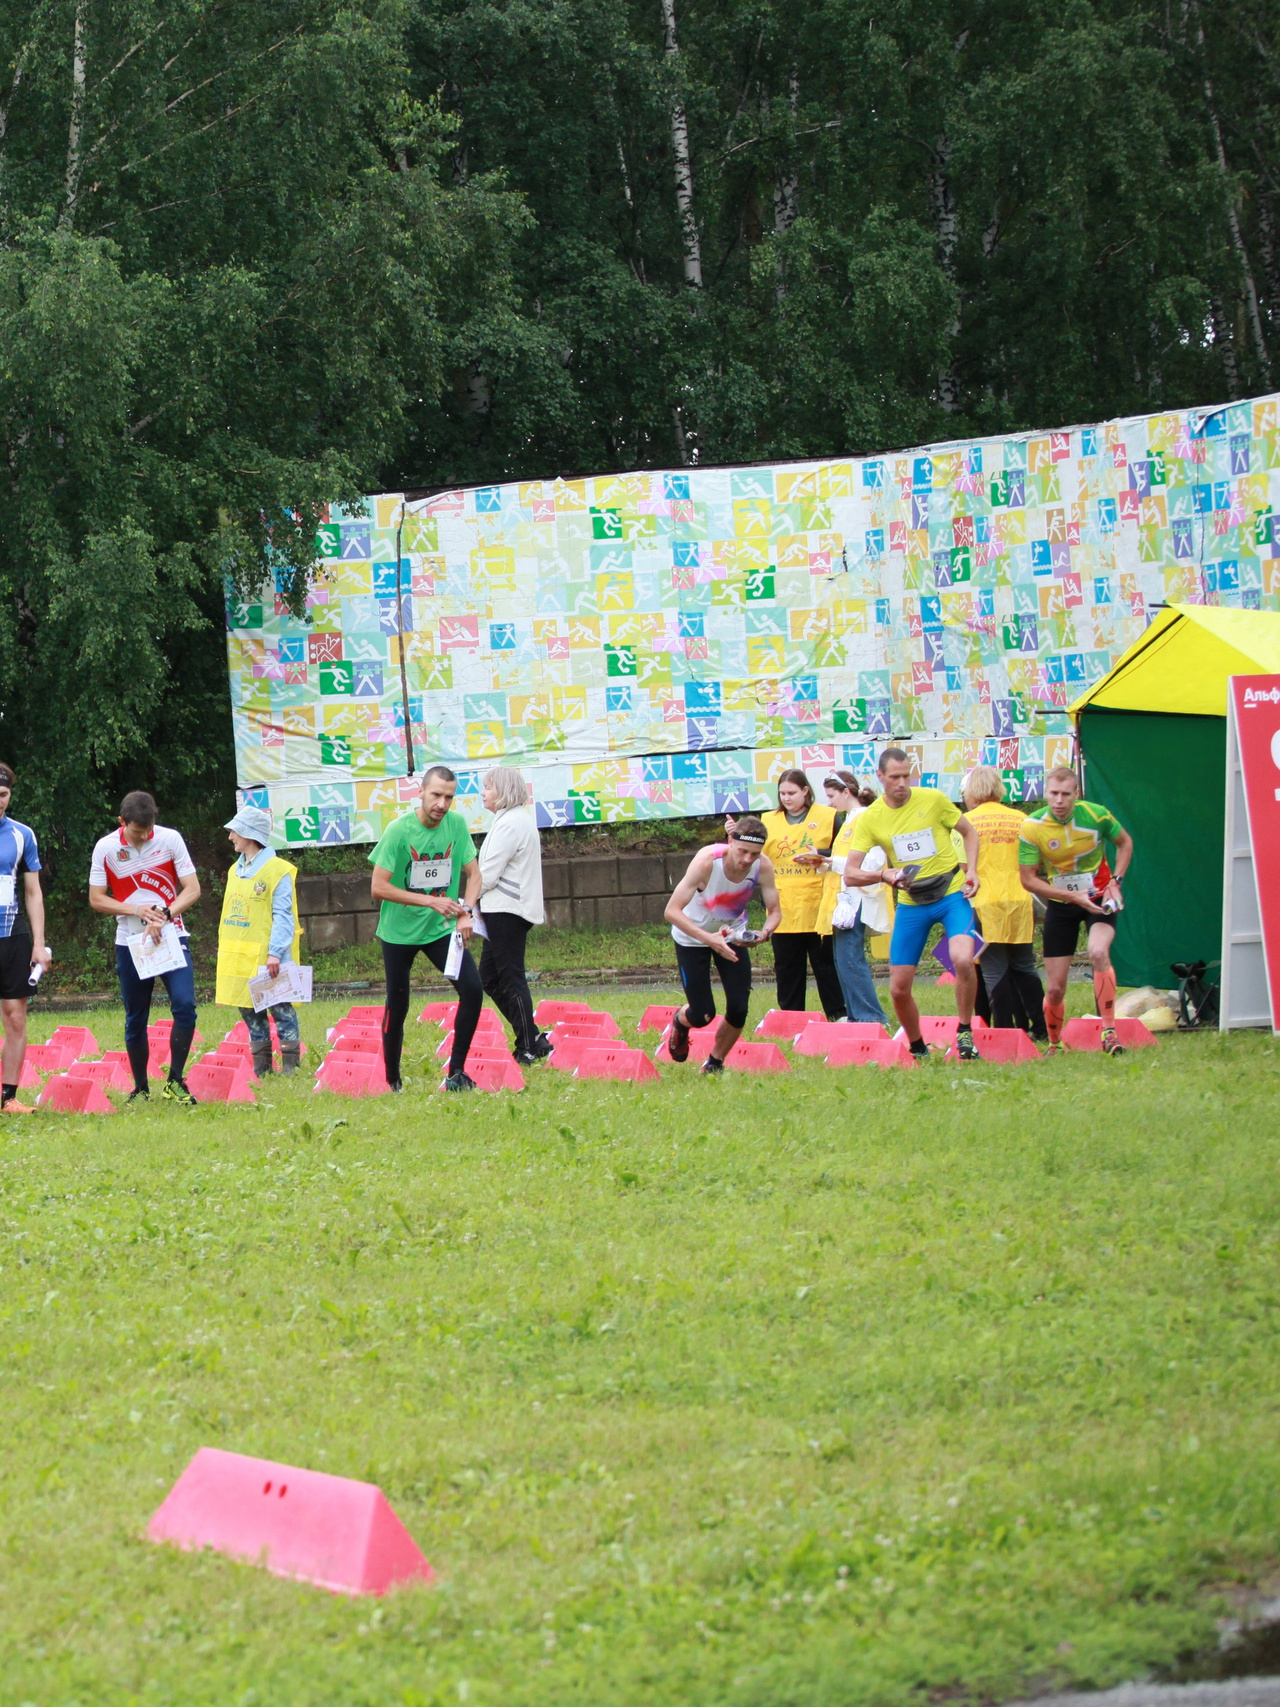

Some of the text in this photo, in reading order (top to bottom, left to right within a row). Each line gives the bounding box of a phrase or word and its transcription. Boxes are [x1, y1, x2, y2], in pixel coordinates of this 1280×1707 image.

[907, 842, 920, 852] 63
[424, 868, 438, 878] 66
[140, 873, 160, 888] Run
[1066, 883, 1079, 892] 61
